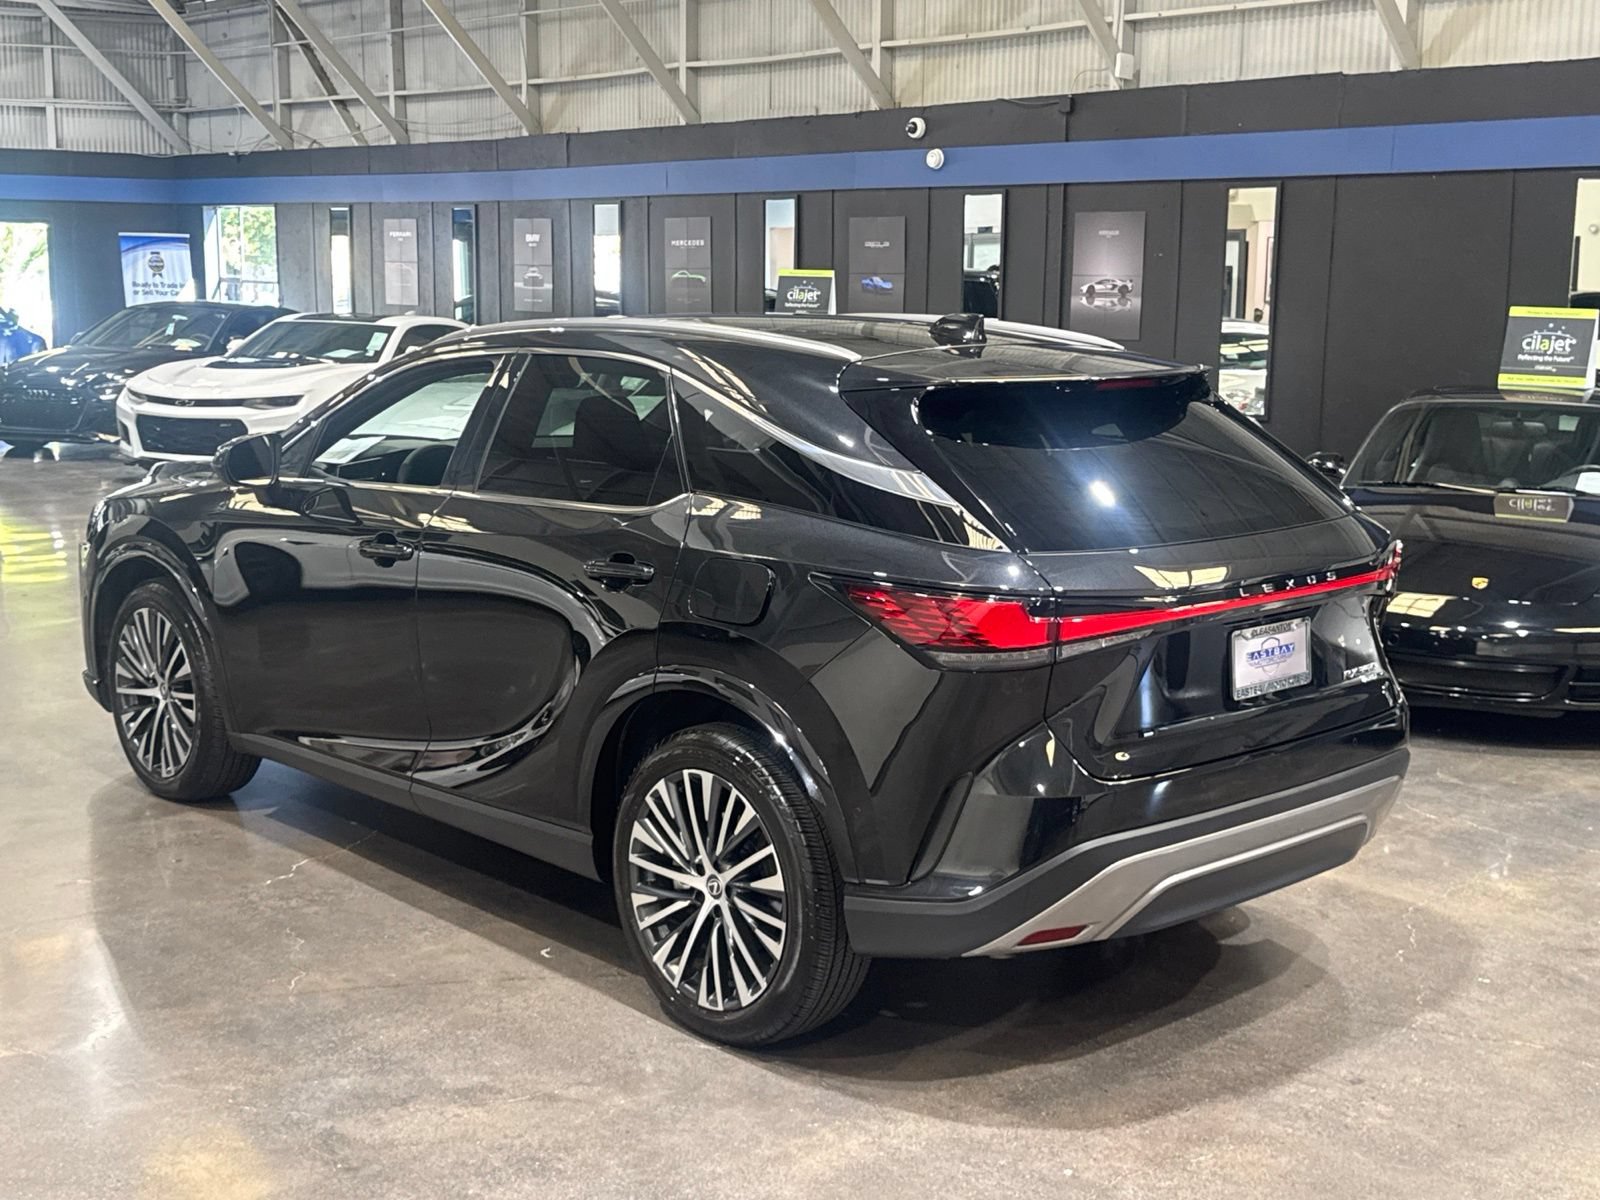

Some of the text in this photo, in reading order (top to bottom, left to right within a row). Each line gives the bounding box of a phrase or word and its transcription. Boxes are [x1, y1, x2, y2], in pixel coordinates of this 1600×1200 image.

[786, 288, 819, 303] cilajet
[1521, 334, 1573, 355] cilajet
[1239, 571, 1338, 597] LEXUS
[1246, 642, 1295, 662] EASTBAY
